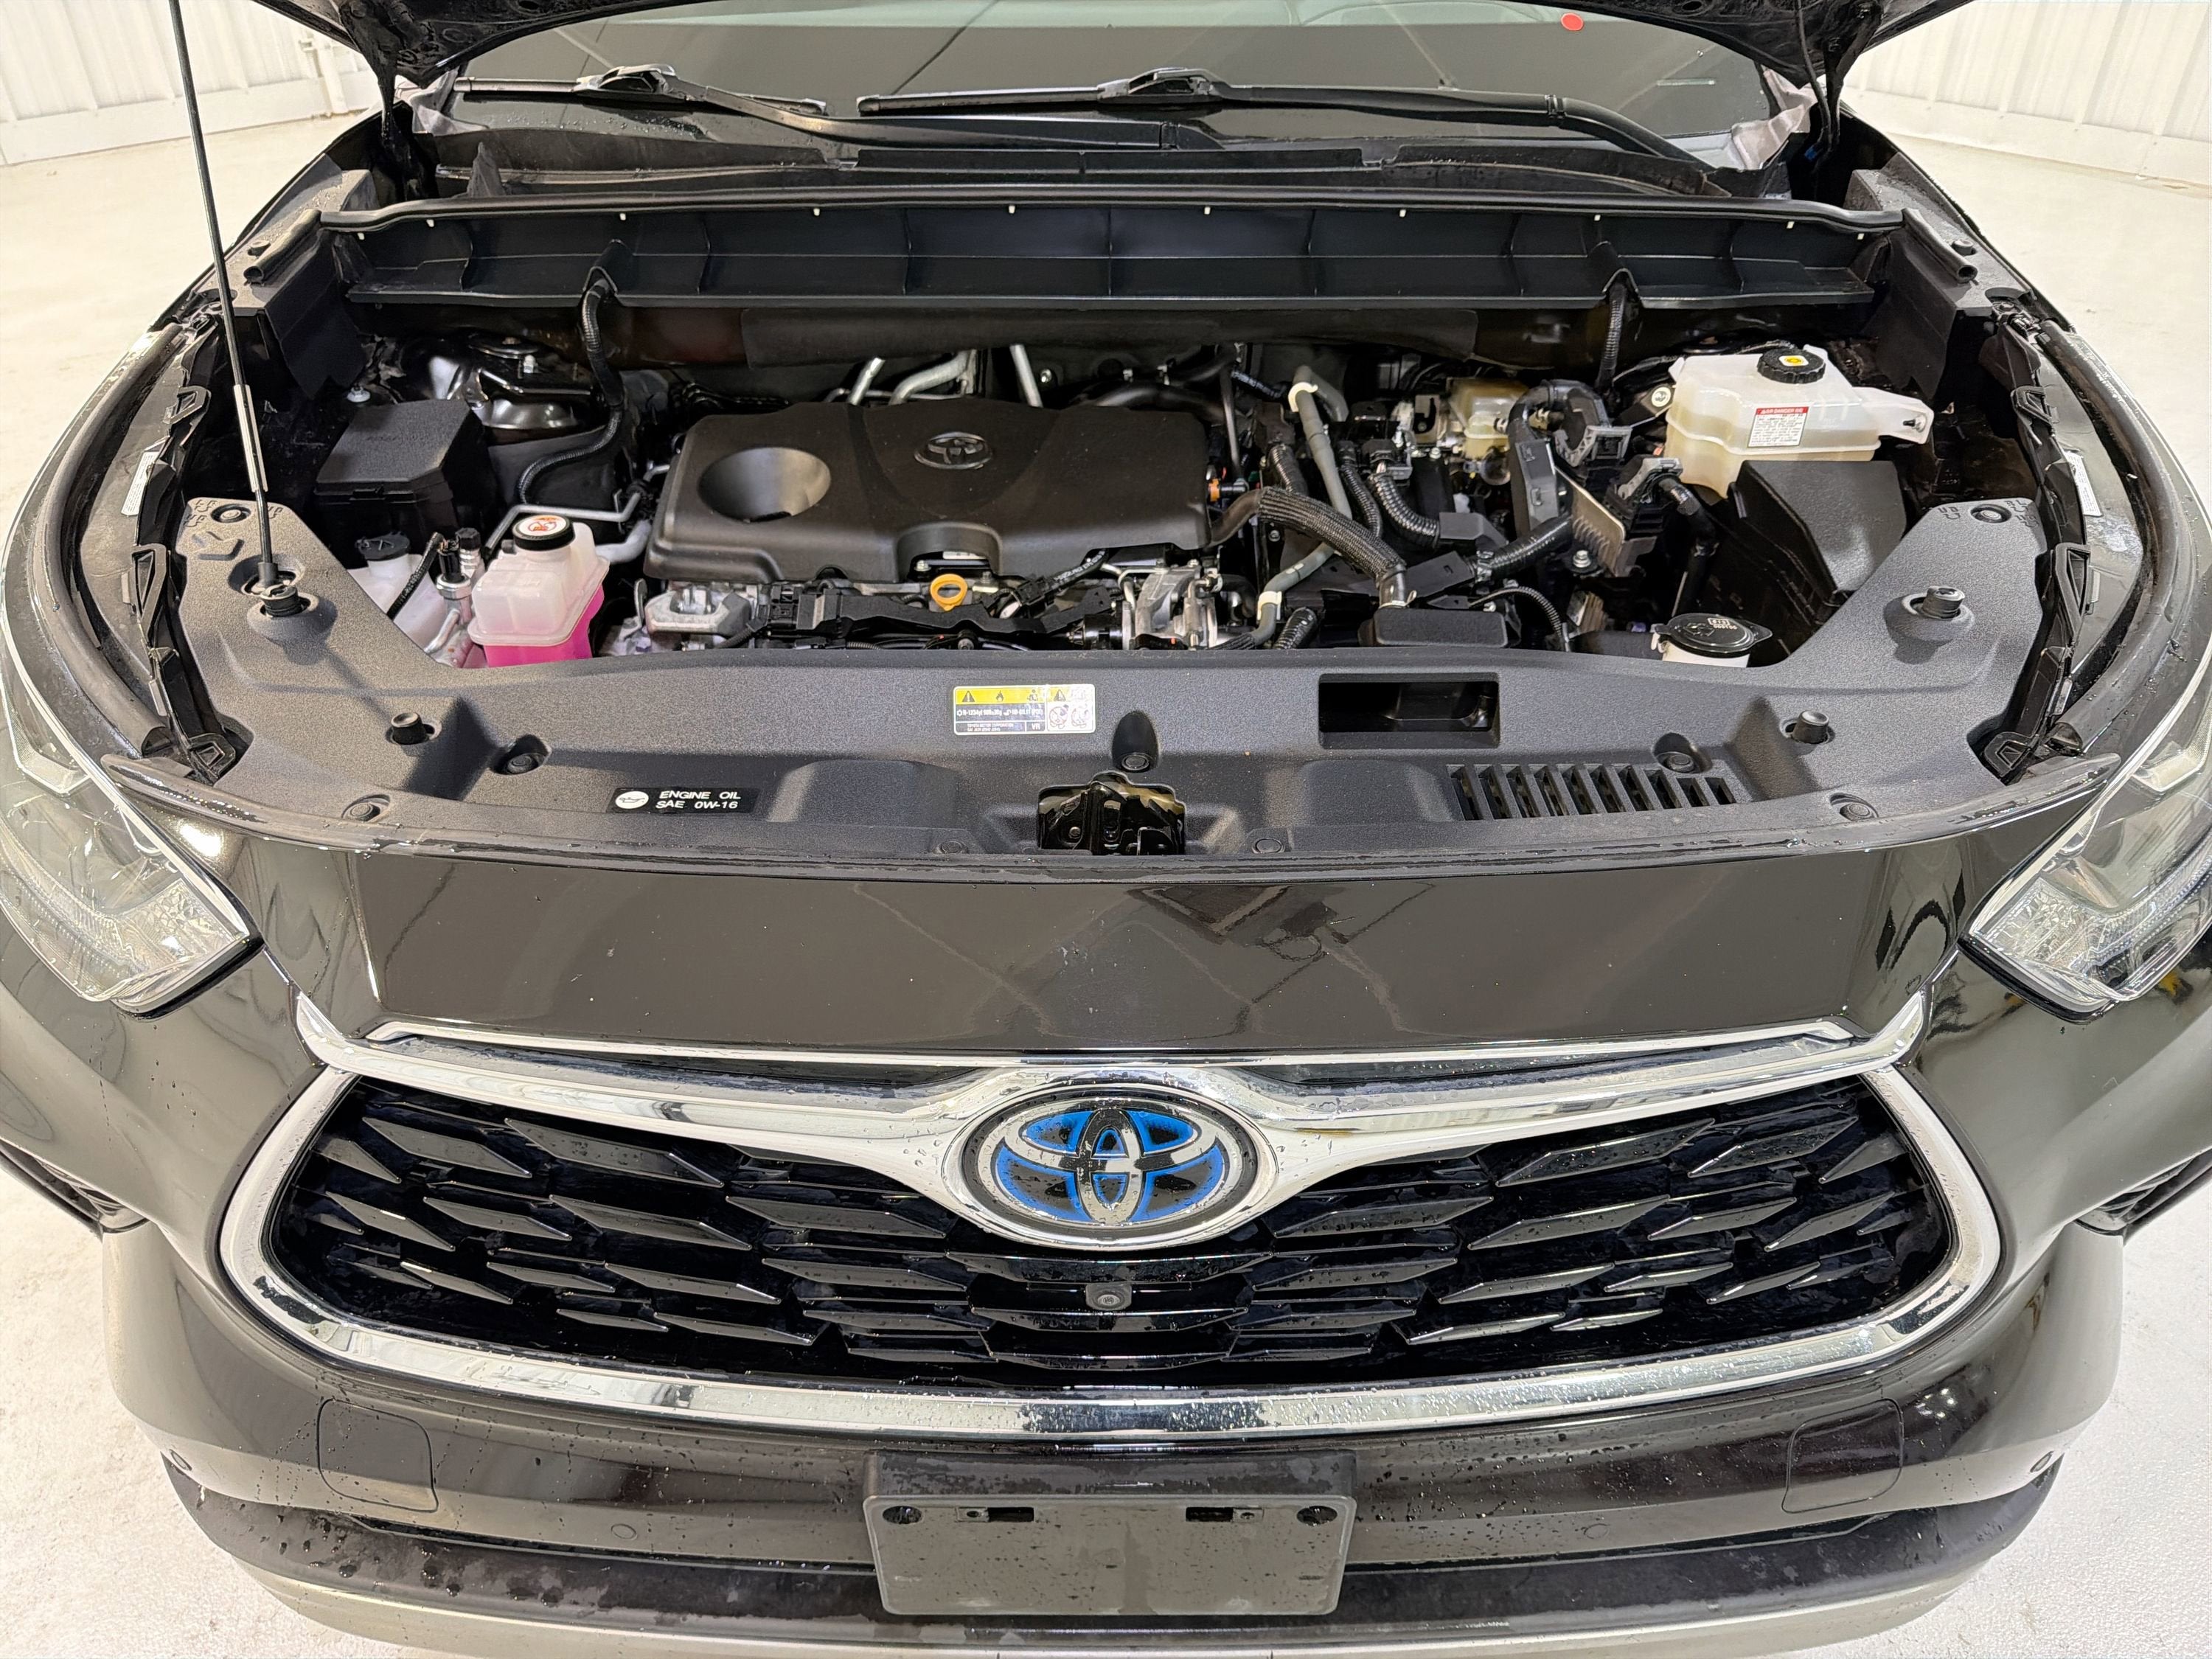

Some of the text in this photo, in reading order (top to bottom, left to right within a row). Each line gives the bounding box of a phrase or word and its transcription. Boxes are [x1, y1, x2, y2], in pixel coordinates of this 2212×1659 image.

[658, 790, 742, 800] ENGINE OIL
[655, 800, 739, 810] SAE 0W-16
